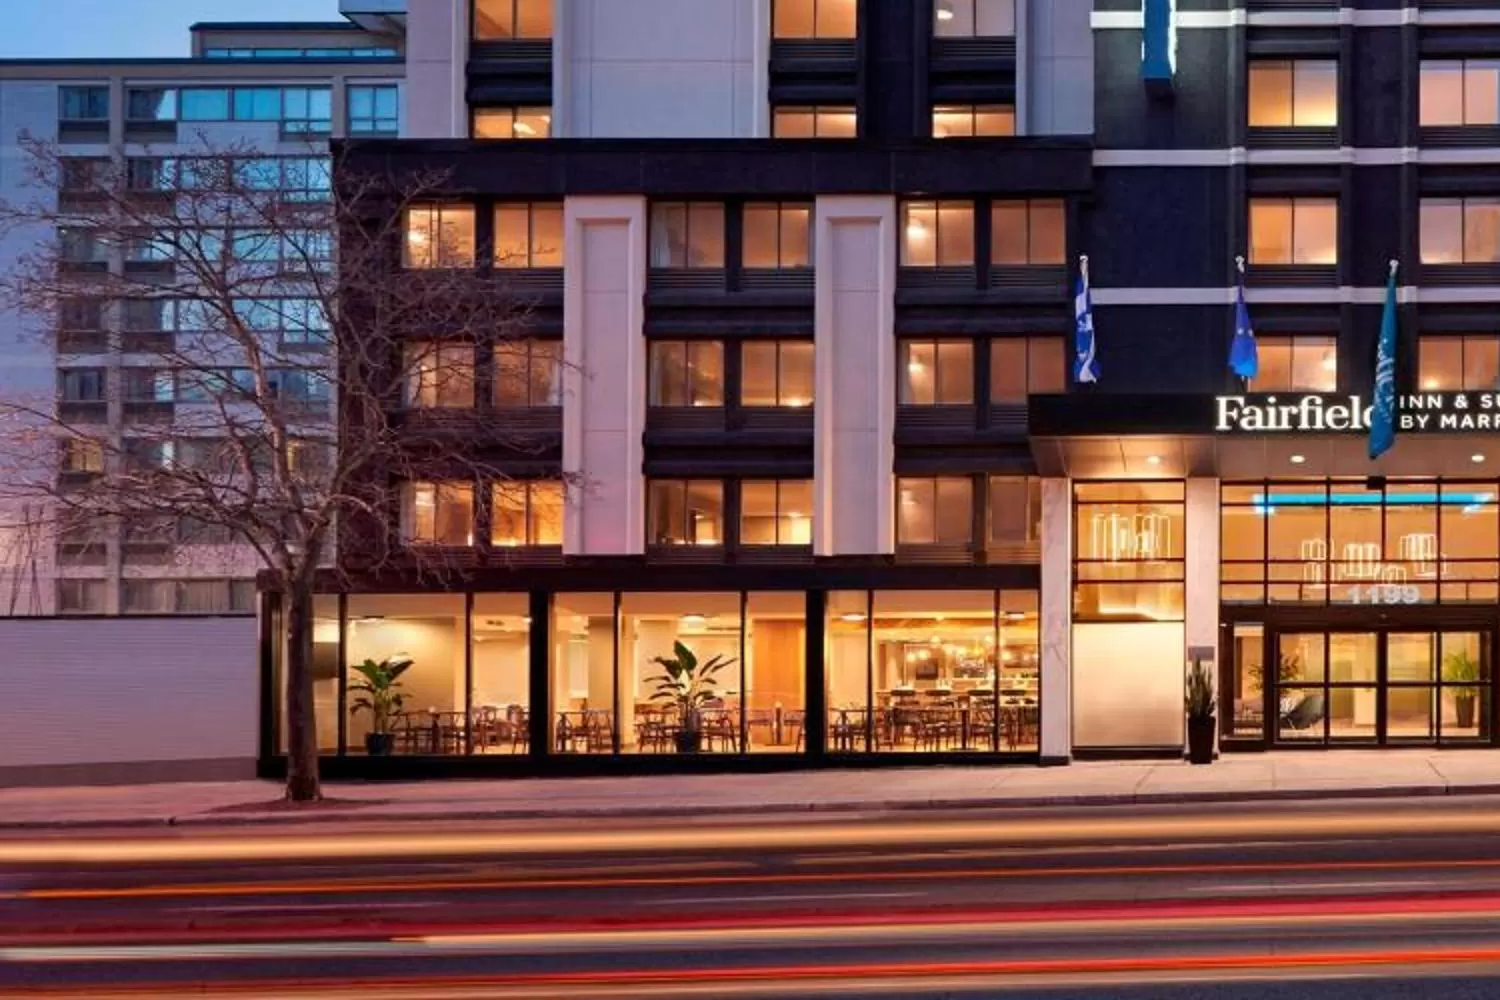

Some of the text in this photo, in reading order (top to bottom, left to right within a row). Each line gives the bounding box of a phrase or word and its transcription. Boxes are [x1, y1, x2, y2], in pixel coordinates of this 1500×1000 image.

[1399, 394, 1442, 409] INN
[1453, 394, 1469, 409] &
[1400, 414, 1430, 429] BY
